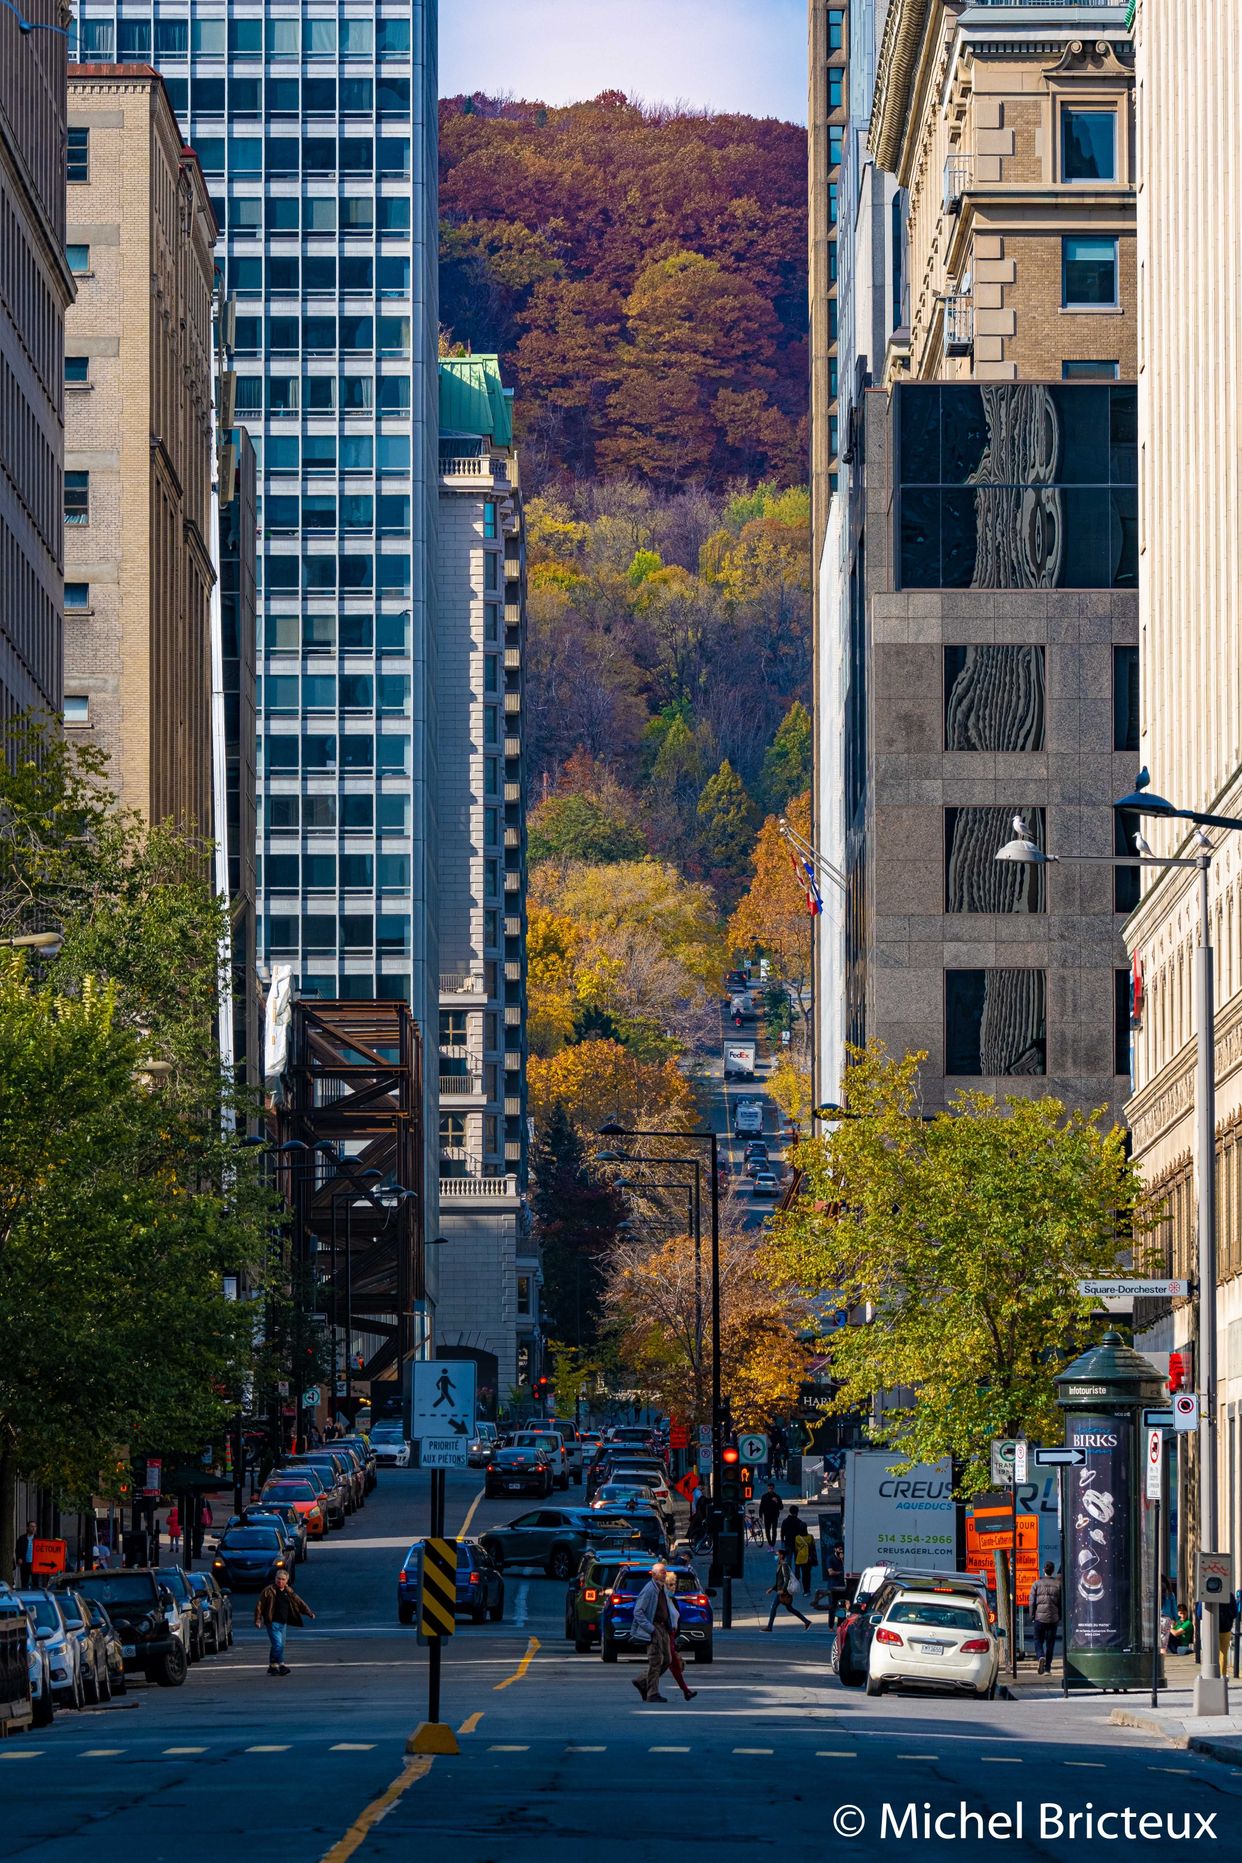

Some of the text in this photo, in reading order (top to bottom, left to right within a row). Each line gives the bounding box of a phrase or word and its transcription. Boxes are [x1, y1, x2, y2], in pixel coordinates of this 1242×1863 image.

[730, 1051, 750, 1059] FedEx
[1084, 1285, 1167, 1295] Square-Dorchester
[1068, 1385, 1107, 1395] Infotouriste
[428, 1440, 459, 1450] PRIORITÉ
[1073, 1434, 1118, 1447] BIRKS
[423, 1453, 465, 1464] AUX PIÉTONS
[896, 1502, 952, 1510] AQUEDUCS
[878, 1534, 952, 1543] 514 354-2966
[877, 1547, 953, 1555] CREUSAGERL.COM
[968, 1556, 994, 1567] Mansfie
